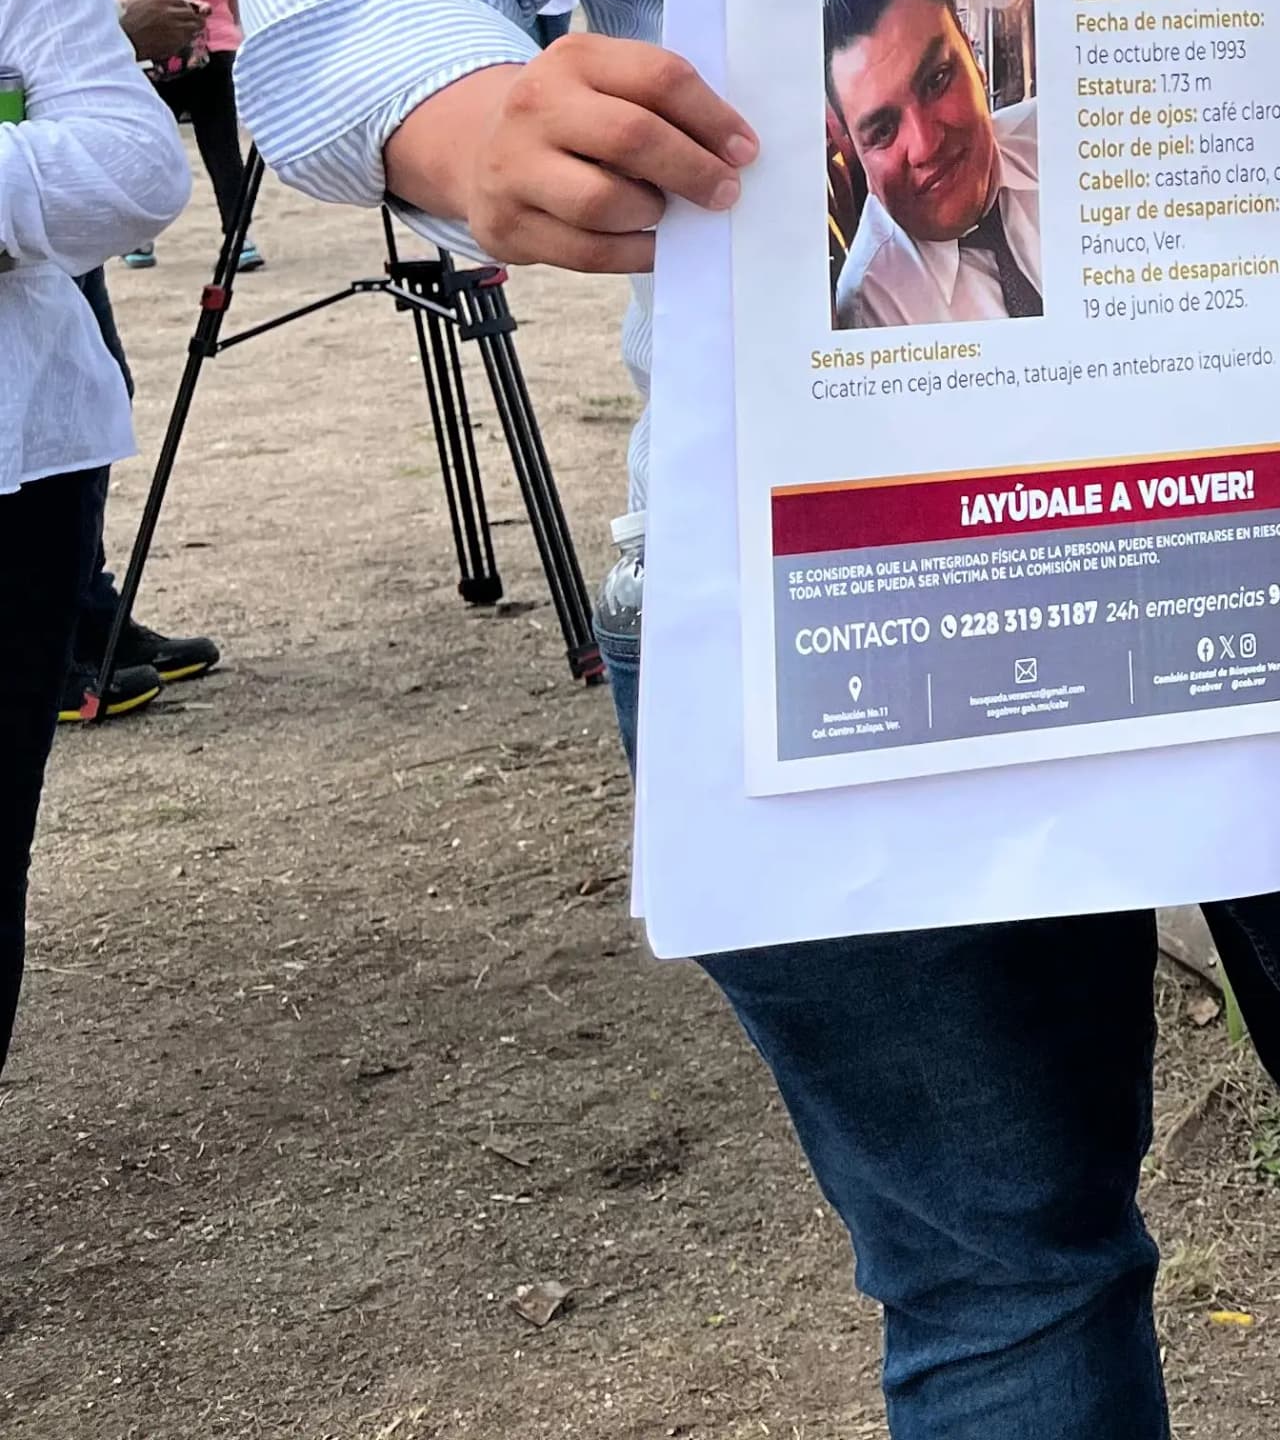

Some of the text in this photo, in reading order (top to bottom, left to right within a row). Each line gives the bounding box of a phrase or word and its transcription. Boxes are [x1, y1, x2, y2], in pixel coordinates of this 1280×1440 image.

[1075, 39, 1246, 64] 1 de octubre de 1993
[1077, 72, 1211, 96] Estatura: 1.73 m
[811, 346, 1275, 399] Cicatriz en ceja derecha, tatuaje en antebrazo izquierdo.
[960, 469, 1254, 526] ¡AYÚDALE A VOLVER!
[795, 616, 930, 655] CONTACTO
[960, 611, 999, 637] 228
[1004, 606, 1042, 632] 319
[1047, 600, 1098, 628] 3187
[1106, 599, 1139, 622] 24h
[1145, 585, 1265, 618] emergencias
